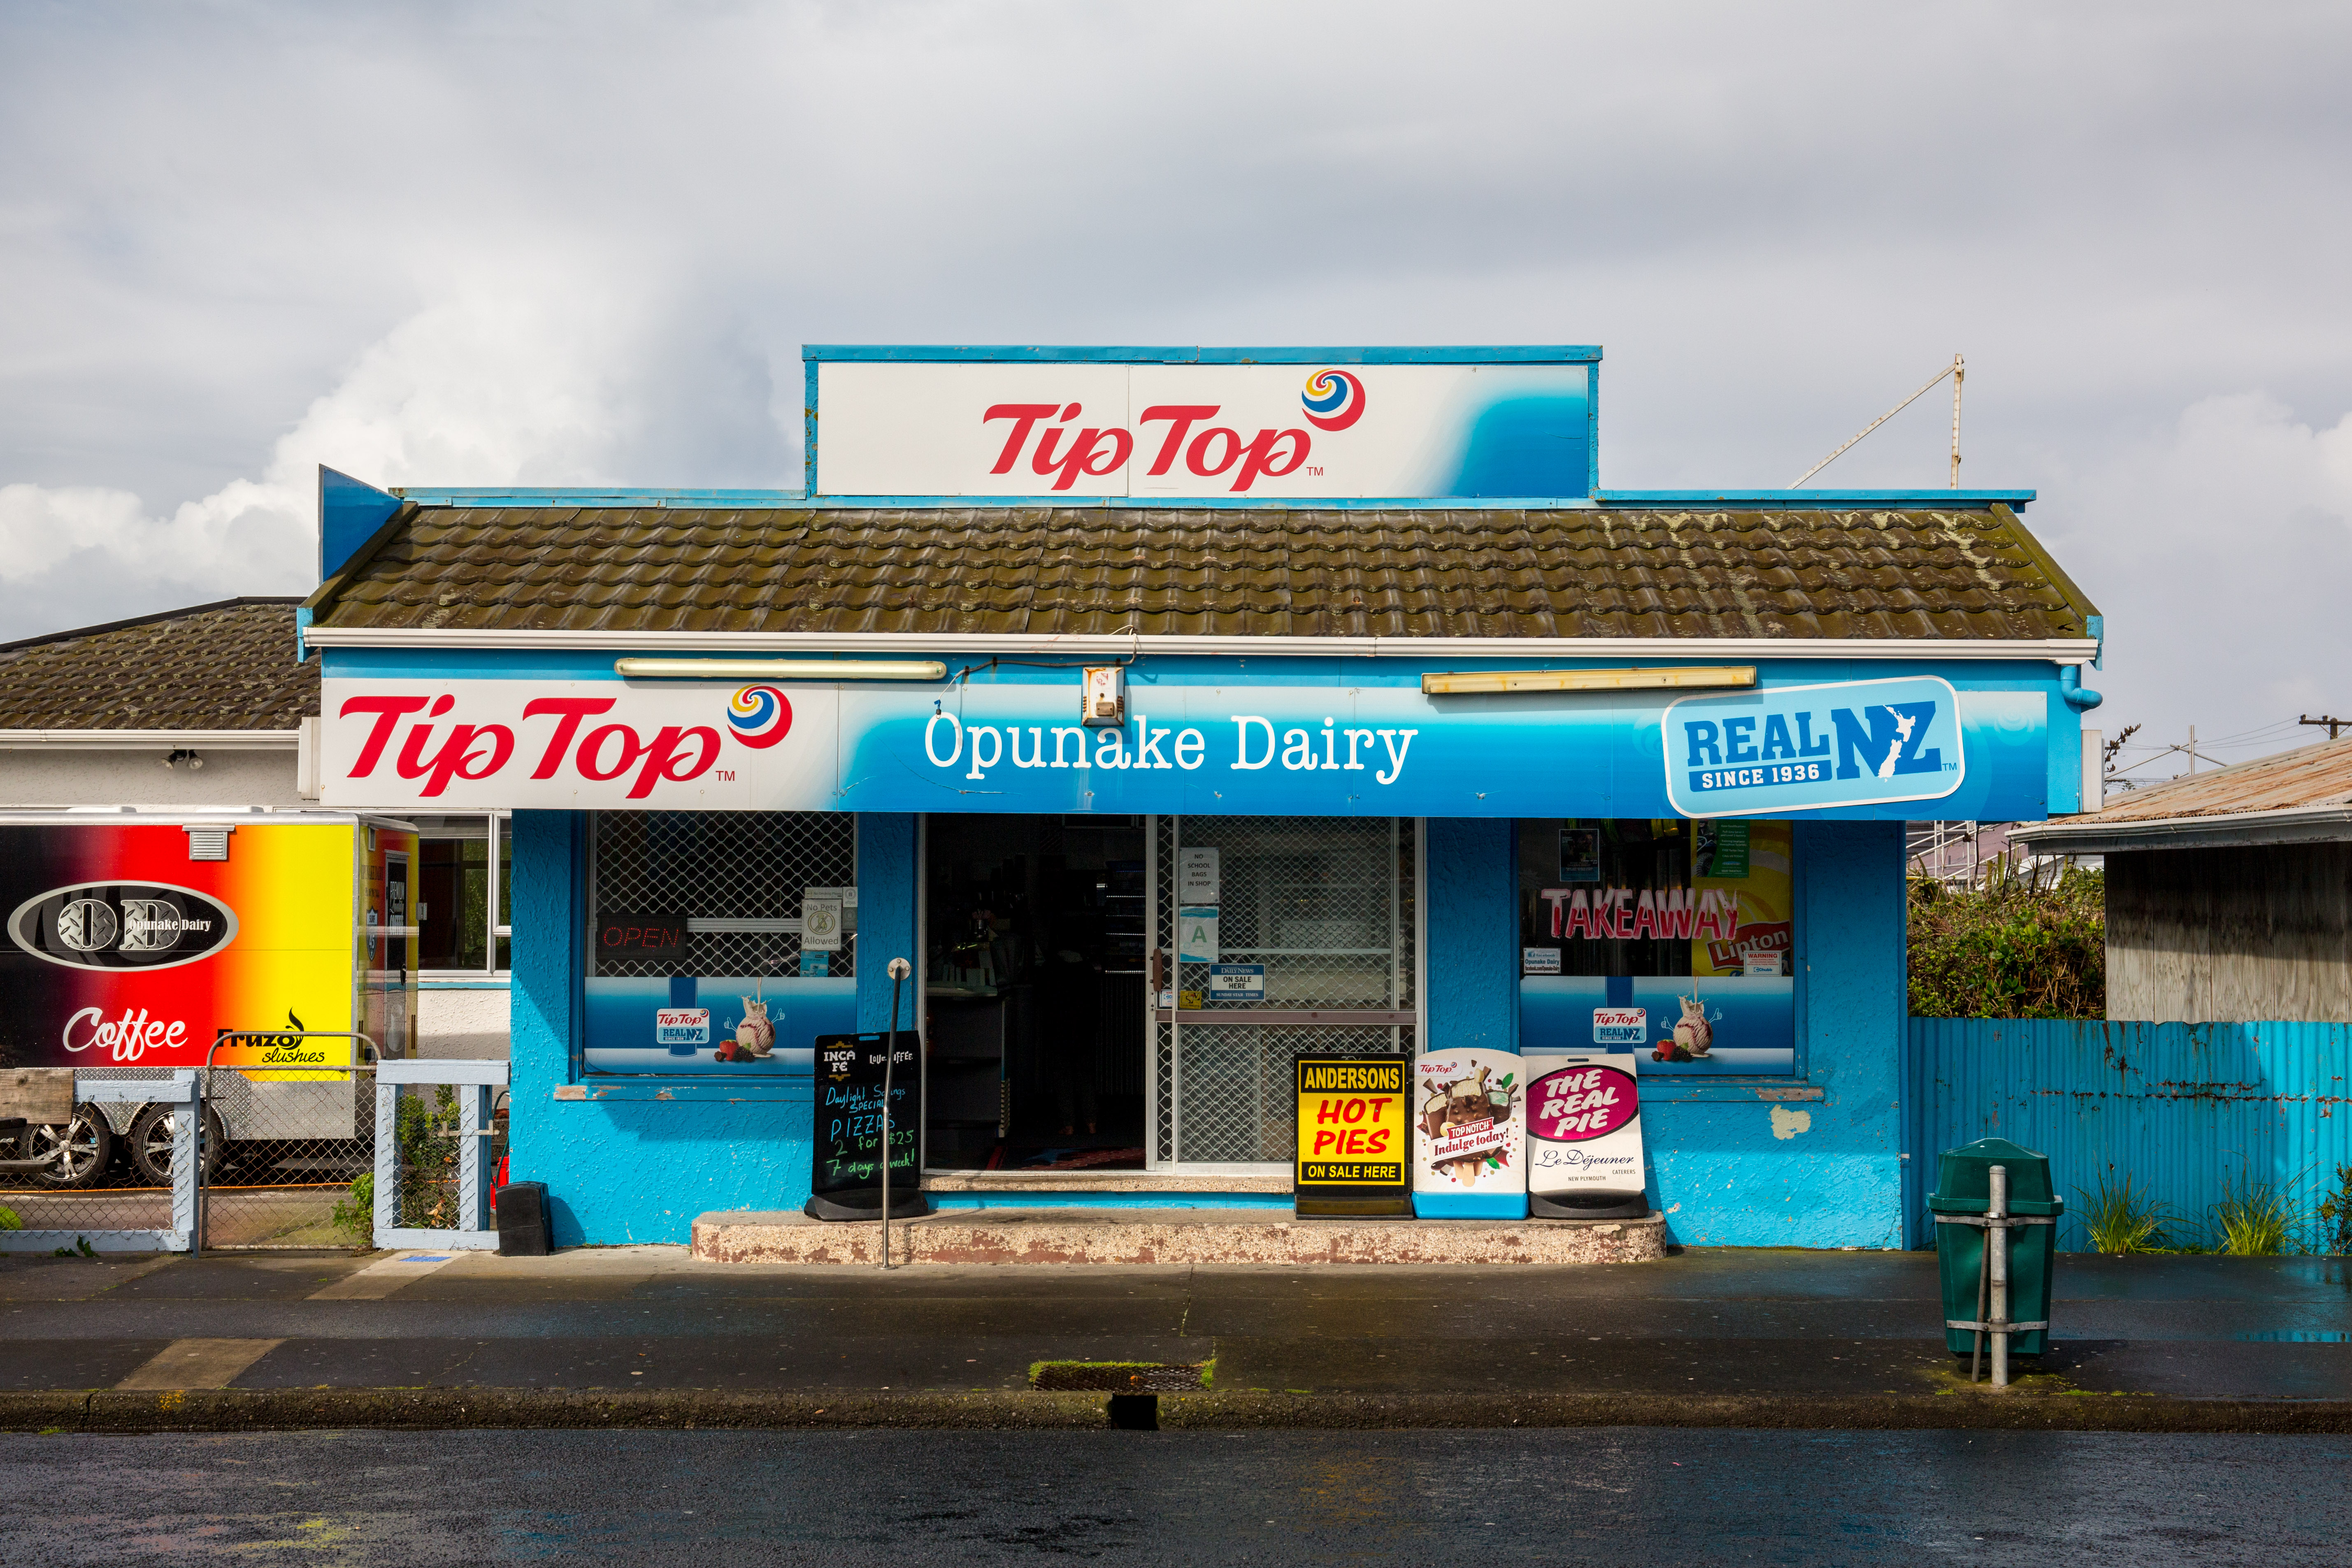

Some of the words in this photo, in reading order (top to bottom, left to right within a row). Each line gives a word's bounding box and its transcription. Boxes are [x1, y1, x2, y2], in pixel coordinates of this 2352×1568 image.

[983, 402, 1133, 490] Tip
[1140, 405, 1311, 492] Top
[1306, 467, 1324, 476] TM
[339, 694, 515, 797] Tip
[522, 697, 721, 799] Top
[716, 770, 735, 781] TM
[925, 712, 1205, 780] Opunake
[1230, 715, 1419, 785] Dairy
[1684, 711, 1831, 767] REAL
[1830, 701, 1943, 780] NZ
[1942, 762, 1957, 771] TM
[1701, 769, 1764, 789] SINCE
[1772, 763, 1820, 783] 1936
[1541, 888, 1742, 940] TAKEAWAY
[129, 919, 179, 931] Opunake
[181, 919, 211, 932] Dairy
[1191, 925, 1207, 943] A
[369, 934, 375, 949] 45
[603, 927, 679, 948] OPEN
[804, 936, 839, 945] Allowed
[1714, 930, 1789, 961] Lipton
[658, 1014, 678, 1026] Tip
[679, 1014, 702, 1026] Top
[1594, 1013, 1615, 1025] Tip
[1615, 1013, 1638, 1025] Top
[63, 1006, 188, 1062] Coffee
[217, 1029, 295, 1048] Fruzo
[686, 1029, 703, 1041] NZ
[1623, 1028, 1640, 1040] NZ
[262, 1047, 325, 1063] slushies
[824, 1050, 856, 1062] INCA
[832, 1060, 848, 1072] FÉ
[1304, 1067, 1399, 1089] ANDERSONS
[1420, 1064, 1435, 1073] Tip
[1435, 1065, 1453, 1074] Top
[1545, 1069, 1603, 1098] THE
[825, 1086, 865, 1109] Daylight
[873, 1084, 906, 1101] Saings
[1539, 1087, 1620, 1119] REAL
[1317, 1097, 1393, 1124] HOT
[1450, 1126, 1465, 1138] TOP
[1465, 1121, 1490, 1135] NOTCH
[1554, 1108, 1610, 1137] PIE
[834, 1140, 848, 1157] 2
[858, 1136, 879, 1151] for
[888, 1129, 914, 1145] $25
[1313, 1128, 1390, 1155] PIES
[1434, 1138, 1474, 1156] Indulge
[1476, 1127, 1509, 1145] today!
[826, 1159, 842, 1176] 7
[848, 1161, 874, 1180] days
[1534, 1150, 1562, 1168] Le
[1563, 1149, 1634, 1171] Déjeuner
[1308, 1165, 1325, 1178] ON
[1329, 1165, 1360, 1178] SALE
[1363, 1166, 1397, 1178] HERE
